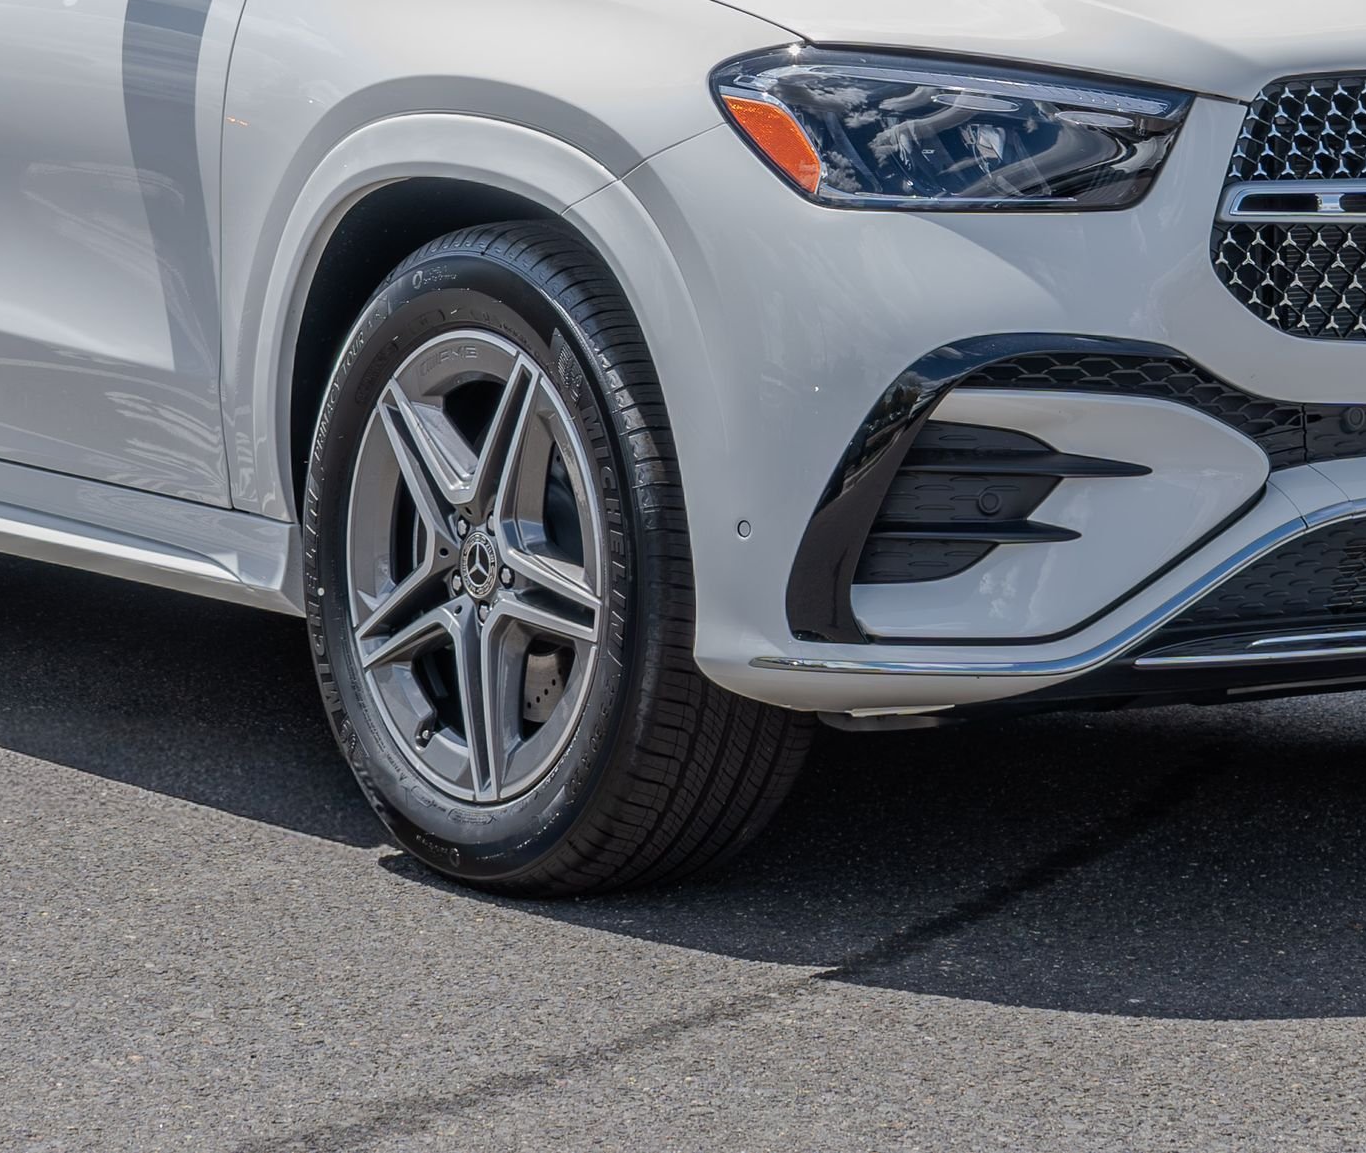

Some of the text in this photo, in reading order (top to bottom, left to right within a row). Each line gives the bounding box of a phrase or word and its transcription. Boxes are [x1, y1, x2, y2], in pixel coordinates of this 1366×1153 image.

[314, 331, 365, 463] PRIMACY TOUR
[581, 403, 627, 649] MICHELIN
